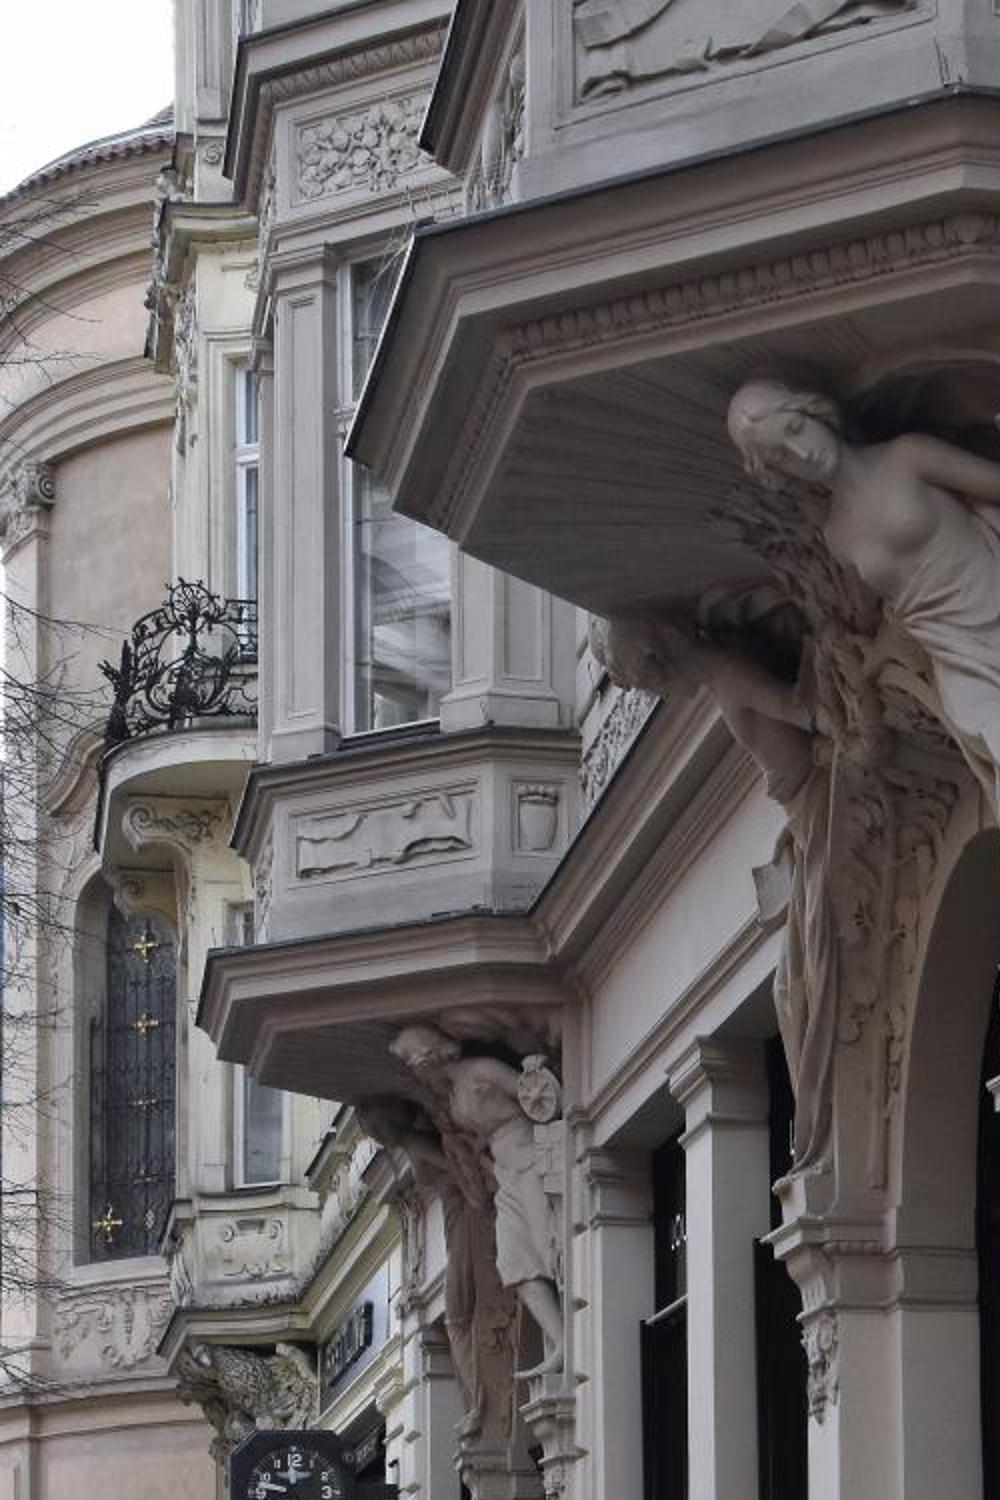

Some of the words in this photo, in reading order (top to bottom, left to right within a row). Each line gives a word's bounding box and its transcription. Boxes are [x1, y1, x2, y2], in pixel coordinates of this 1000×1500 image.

[288, 1453, 302, 1467] 12
[260, 1472, 270, 1481] 10
[256, 1486, 266, 1500] 9
[321, 1486, 332, 1499] 3
